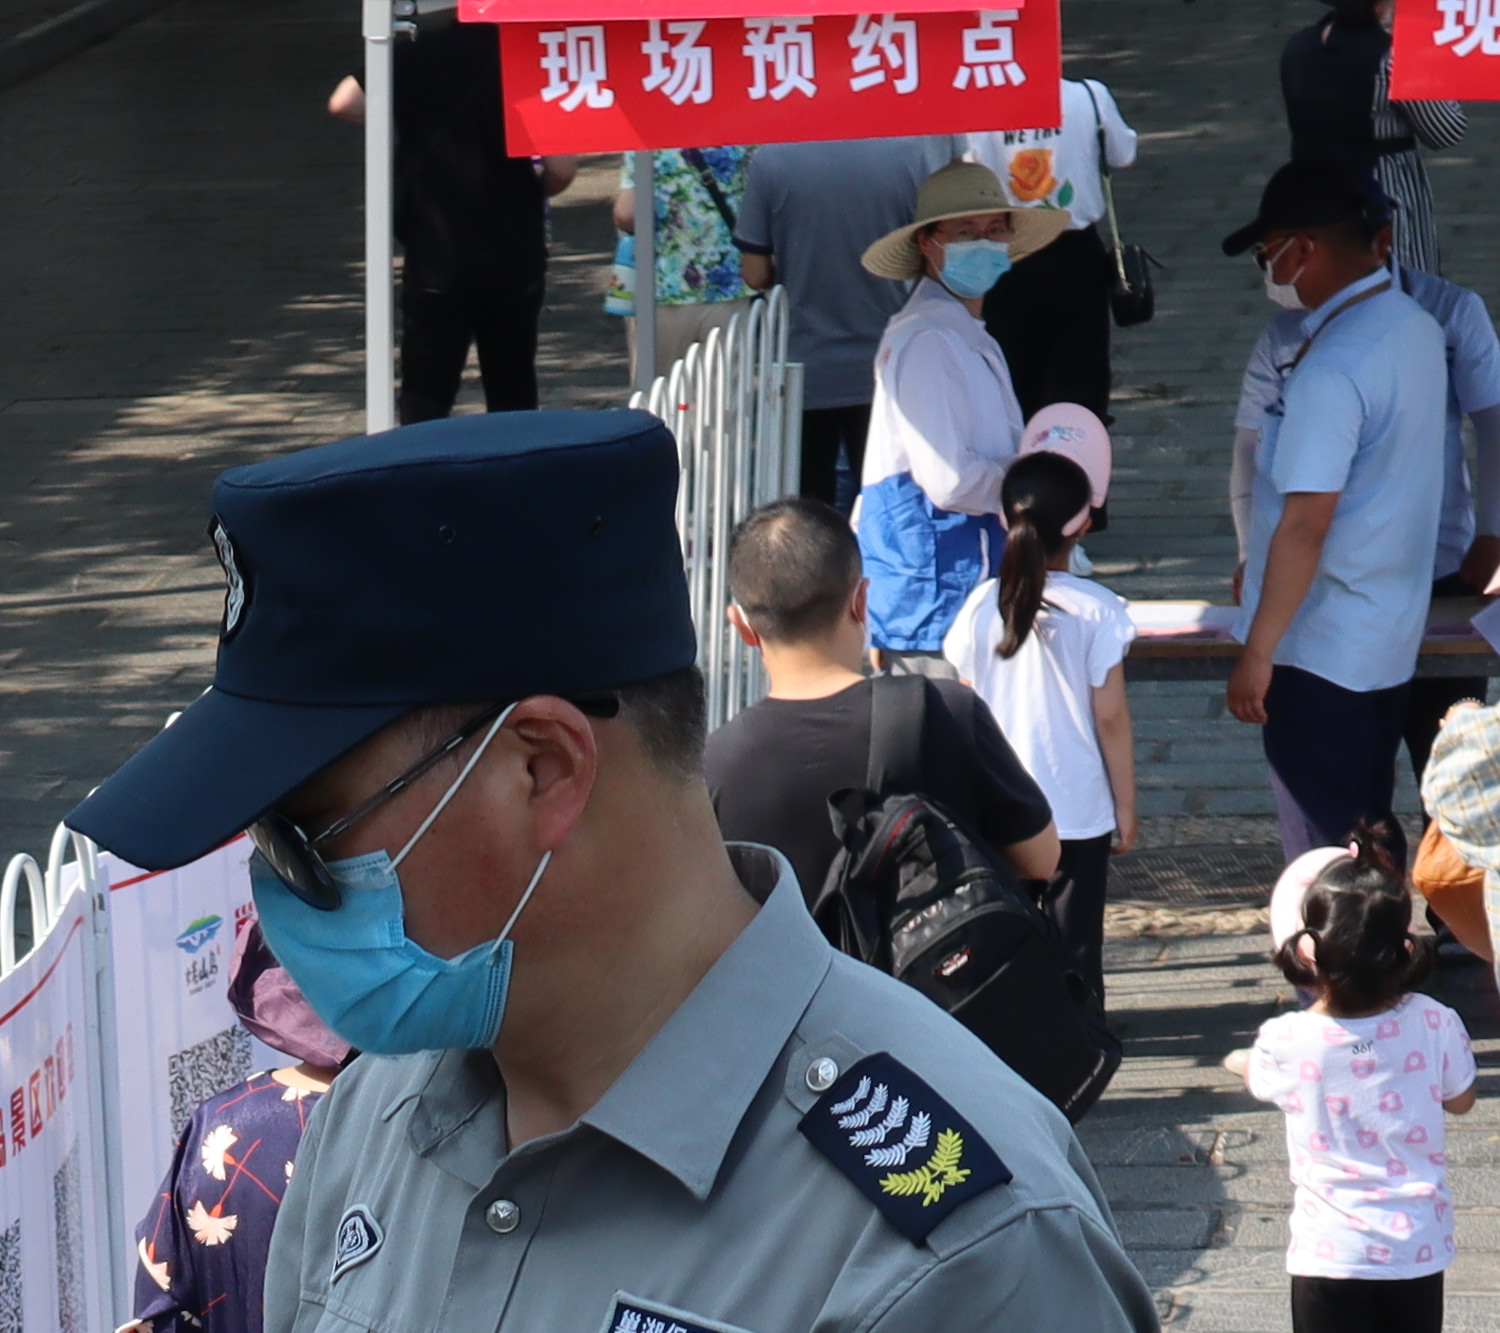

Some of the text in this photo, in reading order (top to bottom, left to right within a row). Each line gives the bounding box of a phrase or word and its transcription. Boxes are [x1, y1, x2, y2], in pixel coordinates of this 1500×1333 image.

[538, 14, 1028, 113] 现场预约点
